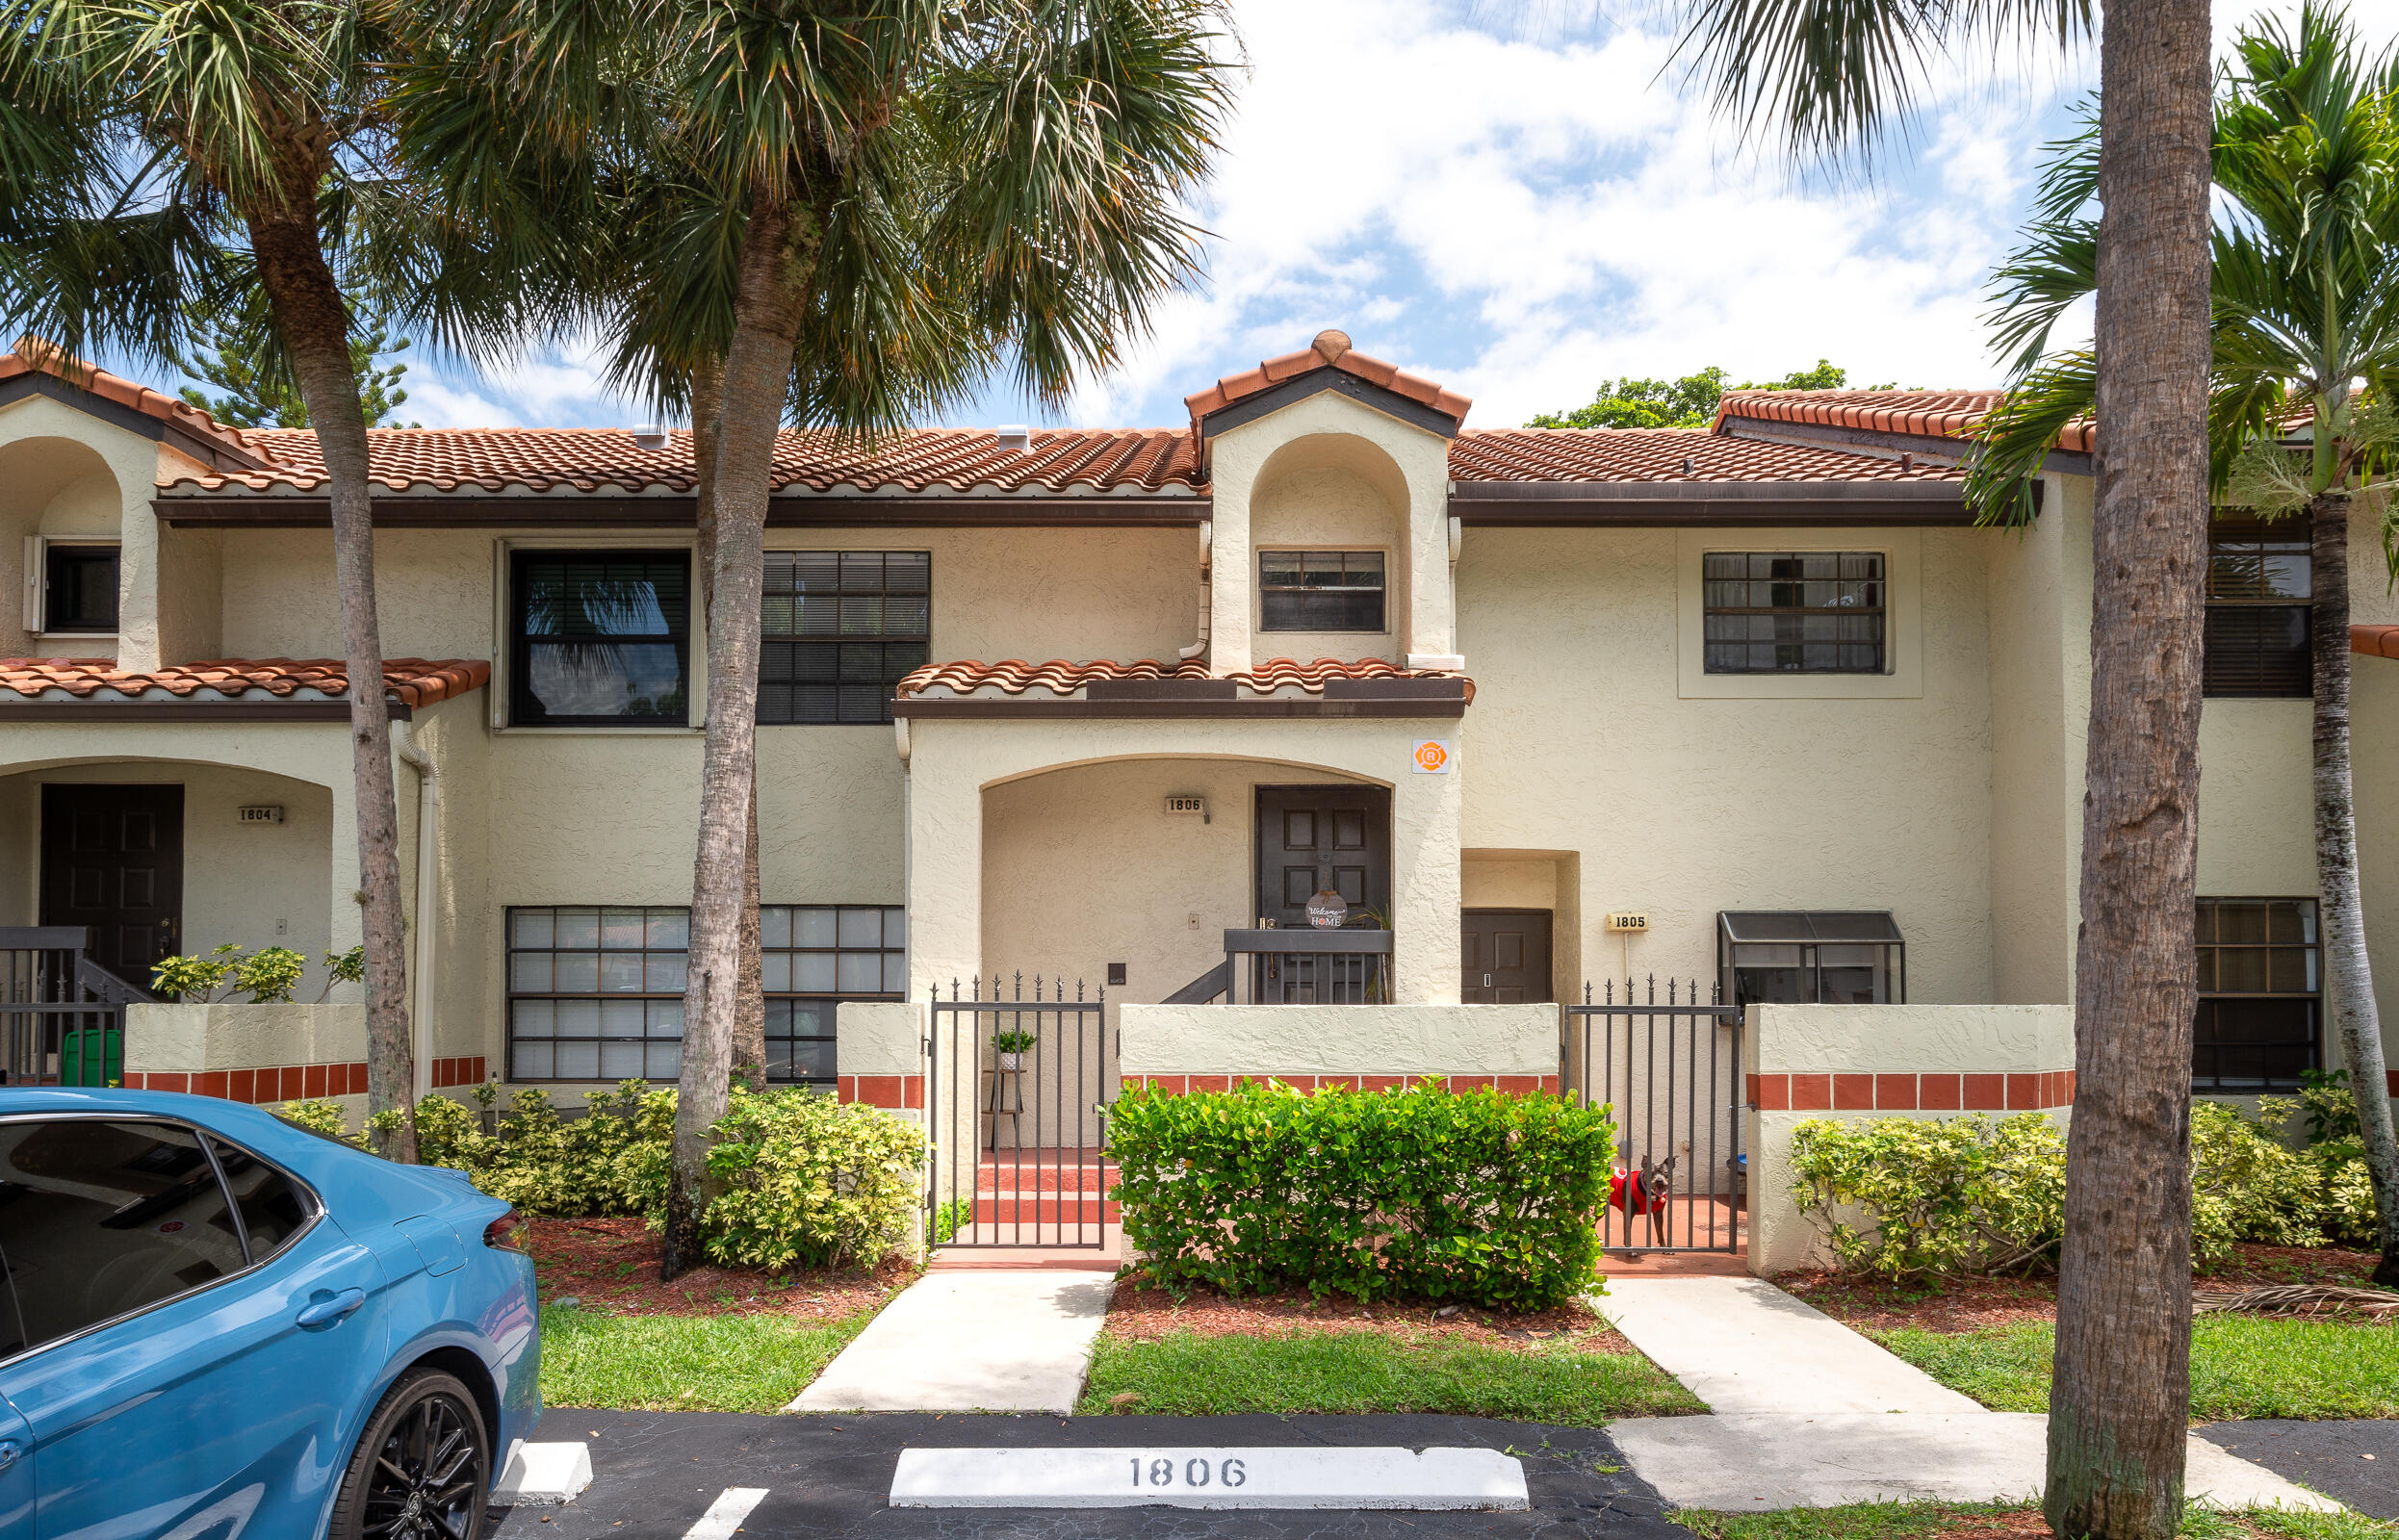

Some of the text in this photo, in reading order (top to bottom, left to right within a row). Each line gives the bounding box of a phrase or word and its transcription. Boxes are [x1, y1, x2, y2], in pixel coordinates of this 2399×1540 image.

[1427, 752, 1435, 760] R
[1170, 800, 1200, 809] 1806
[241, 809, 271, 820] 1804
[1308, 907, 1346, 915] Welcome
[1616, 916, 1645, 927] 1805
[1130, 1458, 1246, 1487] 1806
